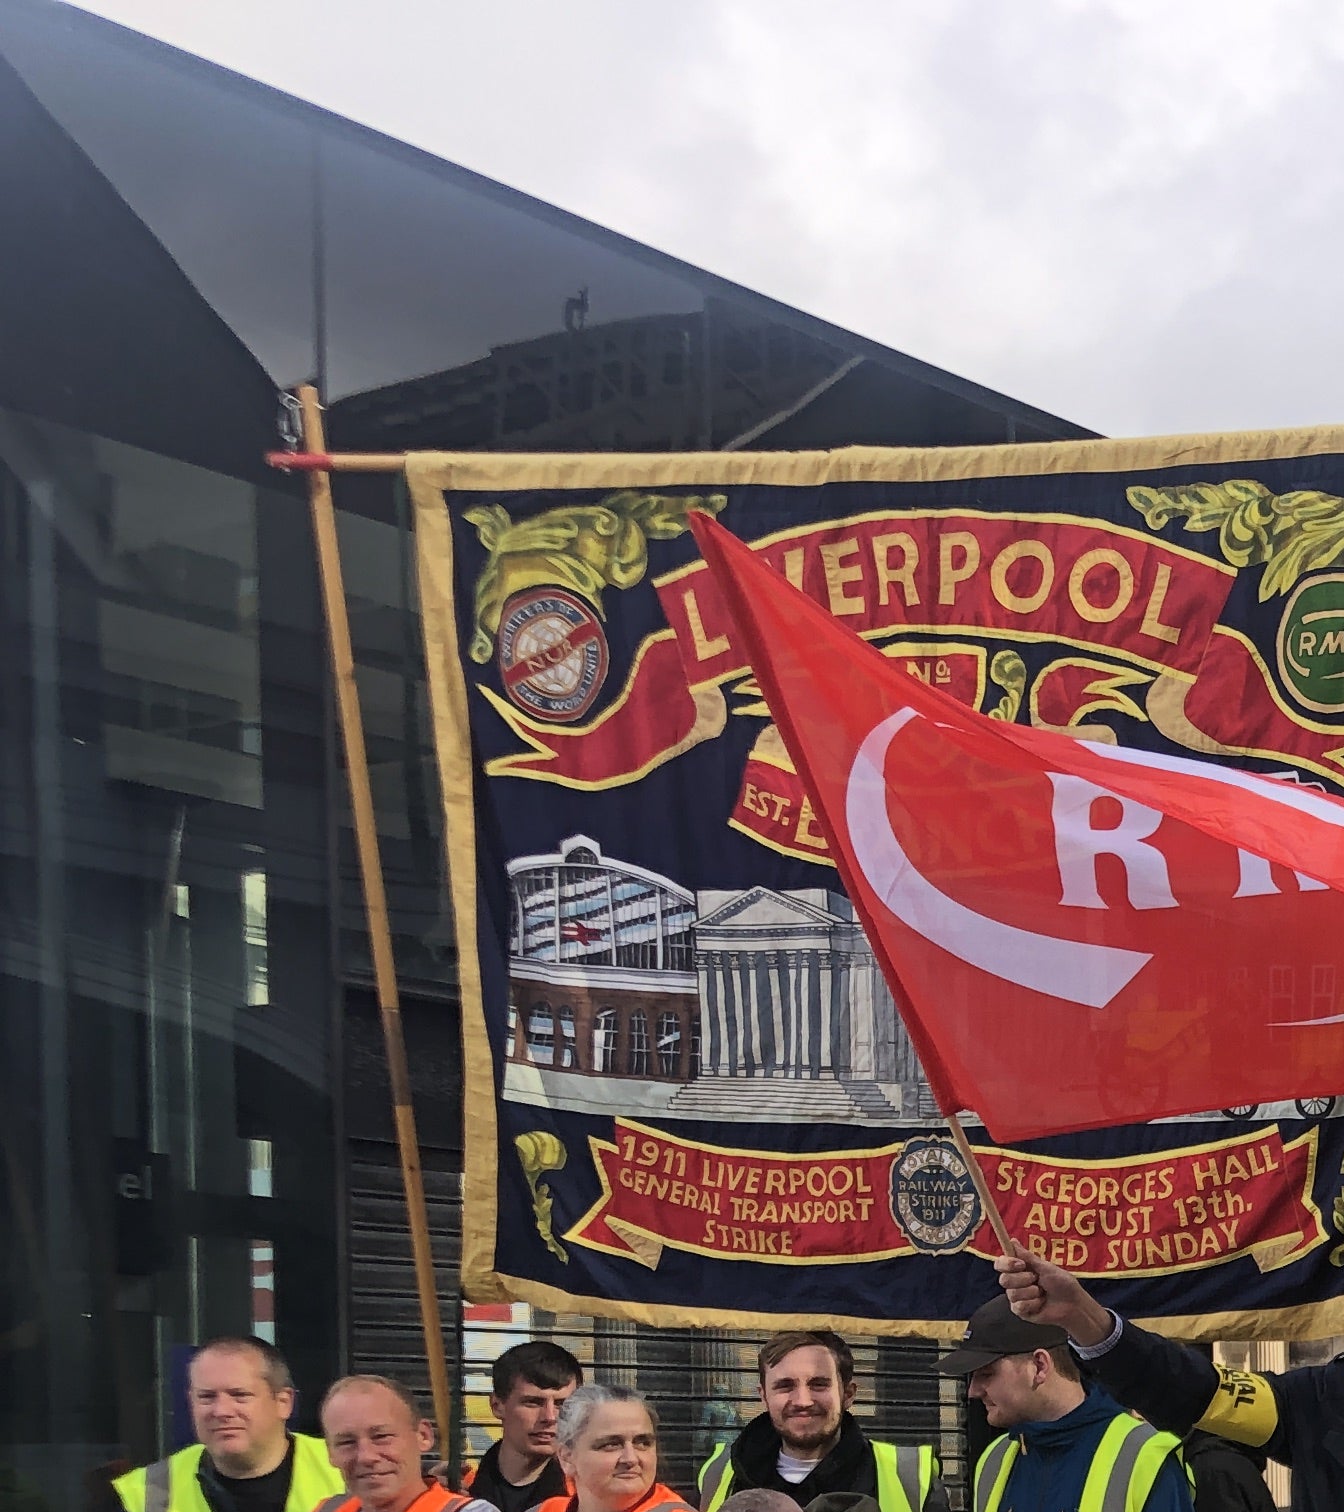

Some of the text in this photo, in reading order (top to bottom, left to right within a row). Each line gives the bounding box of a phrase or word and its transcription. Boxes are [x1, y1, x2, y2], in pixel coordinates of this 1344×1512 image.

[684, 531, 1181, 662] LERPOOL
[742, 782, 791, 826] EST.
[622, 1135, 872, 1198] 1911 LIVERPOOL
[899, 1180, 967, 1192] RAILWAY
[1035, 1166, 1175, 1206] GEORGES
[1194, 1145, 1279, 1192] HALL
[619, 1167, 874, 1224] GENERAL TRANSPORT
[911, 1194, 959, 1208] STRIKE
[922, 1208, 946, 1220] 1911
[1024, 1190, 1253, 1237] AUGUST 13th.
[702, 1219, 794, 1255] STRIKE
[1029, 1222, 1238, 1270] RED SUNDAY
